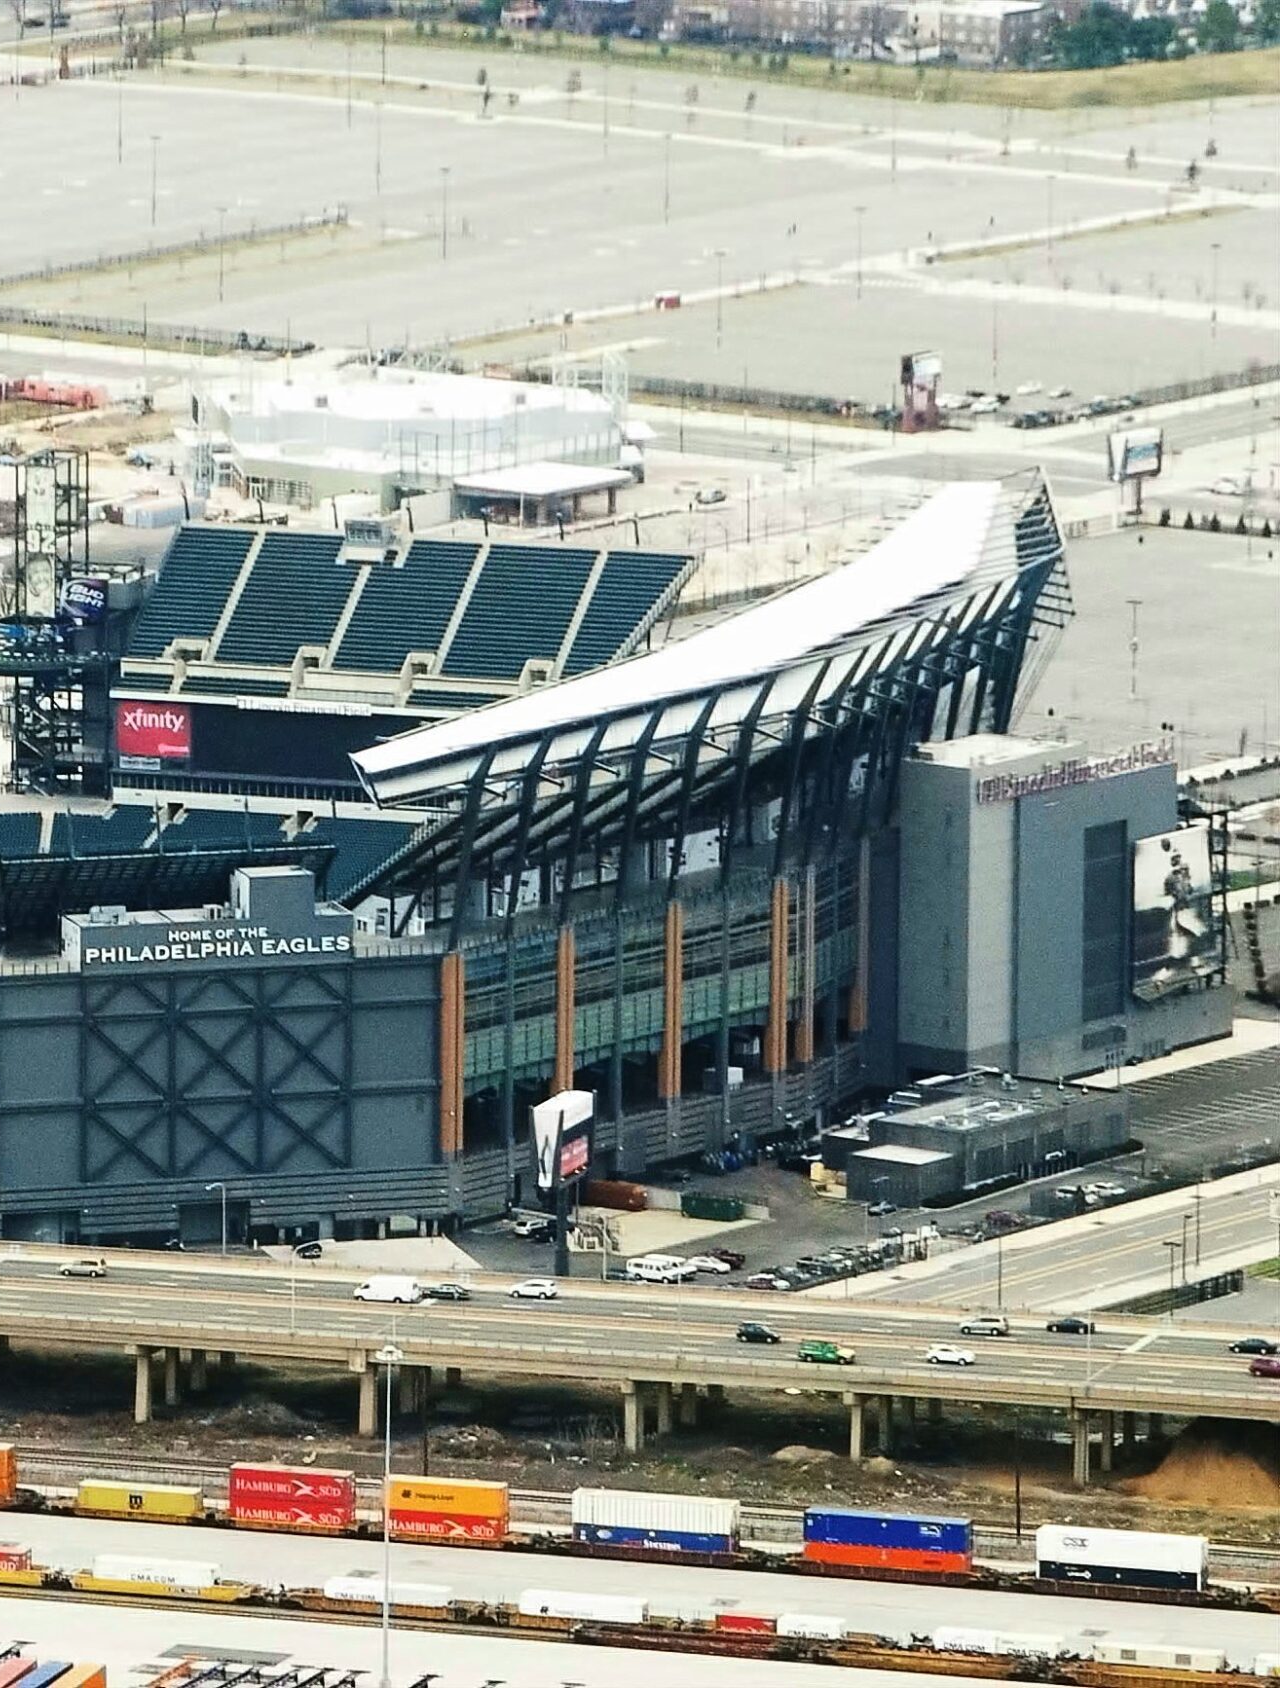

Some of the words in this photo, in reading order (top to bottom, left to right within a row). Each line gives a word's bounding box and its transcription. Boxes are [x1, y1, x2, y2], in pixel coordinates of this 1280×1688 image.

[69, 583, 105, 600] BUD
[124, 708, 184, 733] xfinity
[168, 930, 212, 943] HOME
[216, 929, 236, 940] OF
[239, 927, 269, 939] THE
[85, 941, 255, 964] PHILADELPHIA
[261, 935, 351, 955] EAGLES
[236, 1478, 292, 1495] HAMBURG
[236, 1507, 292, 1522] HAMBURG
[388, 1519, 445, 1534] HAMBURG
[1063, 1536, 1089, 1548] CSX
